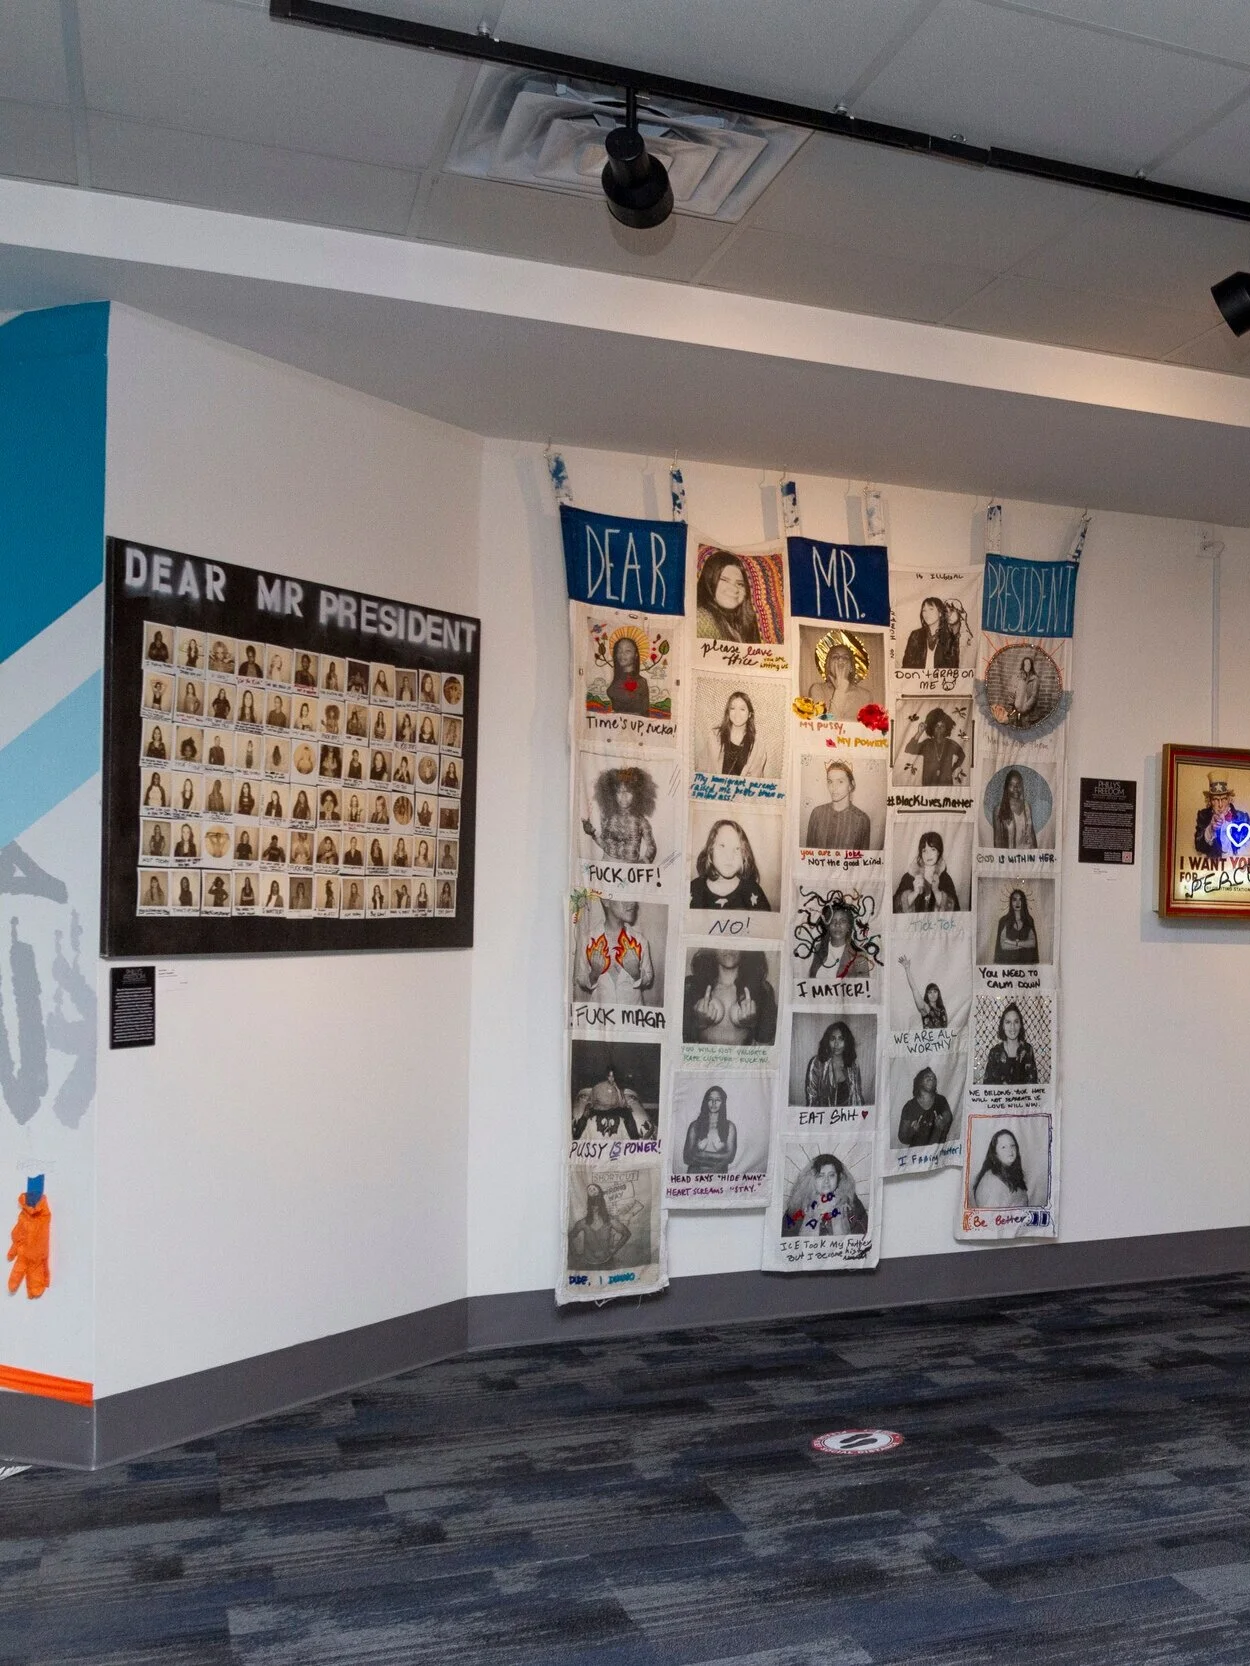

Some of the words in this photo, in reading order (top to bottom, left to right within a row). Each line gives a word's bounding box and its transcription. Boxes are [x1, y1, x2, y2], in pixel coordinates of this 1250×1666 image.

[585, 524, 667, 608] DEAR
[812, 545, 867, 620] MR.
[124, 546, 227, 602] DEAR
[256, 574, 305, 618] MR
[319, 589, 478, 655] PRESIDENT
[986, 561, 1075, 634] PRESIDENT
[700, 639, 741, 658] please
[744, 646, 773, 657] leave
[932, 669, 959, 680] GRAB
[919, 680, 937, 690] ME
[586, 715, 627, 731] Time's
[800, 850, 815, 861] you
[1008, 854, 1036, 864] WITHIN
[808, 858, 826, 867] NOT
[826, 859, 841, 867] the
[842, 859, 860, 871] good
[1180, 856, 1185, 870] I
[1188, 856, 1227, 872] WANT
[588, 864, 626, 883] FUCK
[627, 867, 662, 888] OFF!
[1180, 872, 1198, 883] FOR
[708, 916, 750, 935] NO!
[1002, 968, 1025, 979] NEED
[1026, 968, 1039, 978] TO
[796, 982, 810, 999] I
[812, 980, 872, 999] MATTER!
[986, 979, 1014, 989] CALM
[1018, 978, 1041, 989] DOWN
[621, 1009, 667, 1029] MAGA
[894, 1032, 909, 1045] WE
[914, 1030, 934, 1043] ARE
[938, 1029, 958, 1040] ALL
[906, 1038, 952, 1054] WORTHY
[968, 1089, 980, 1097] WE
[799, 1110, 826, 1125] EAT
[568, 1141, 609, 1159] PUSSY
[609, 1142, 621, 1162] IS
[622, 1140, 662, 1155] POWER!
[898, 1155, 908, 1167] I
[670, 1175, 692, 1184] HEAD
[694, 1174, 713, 1183] SAYS
[666, 1187, 692, 1196] HEART
[692, 1186, 724, 1195] SCREAMS
[973, 1215, 988, 1228] Be
